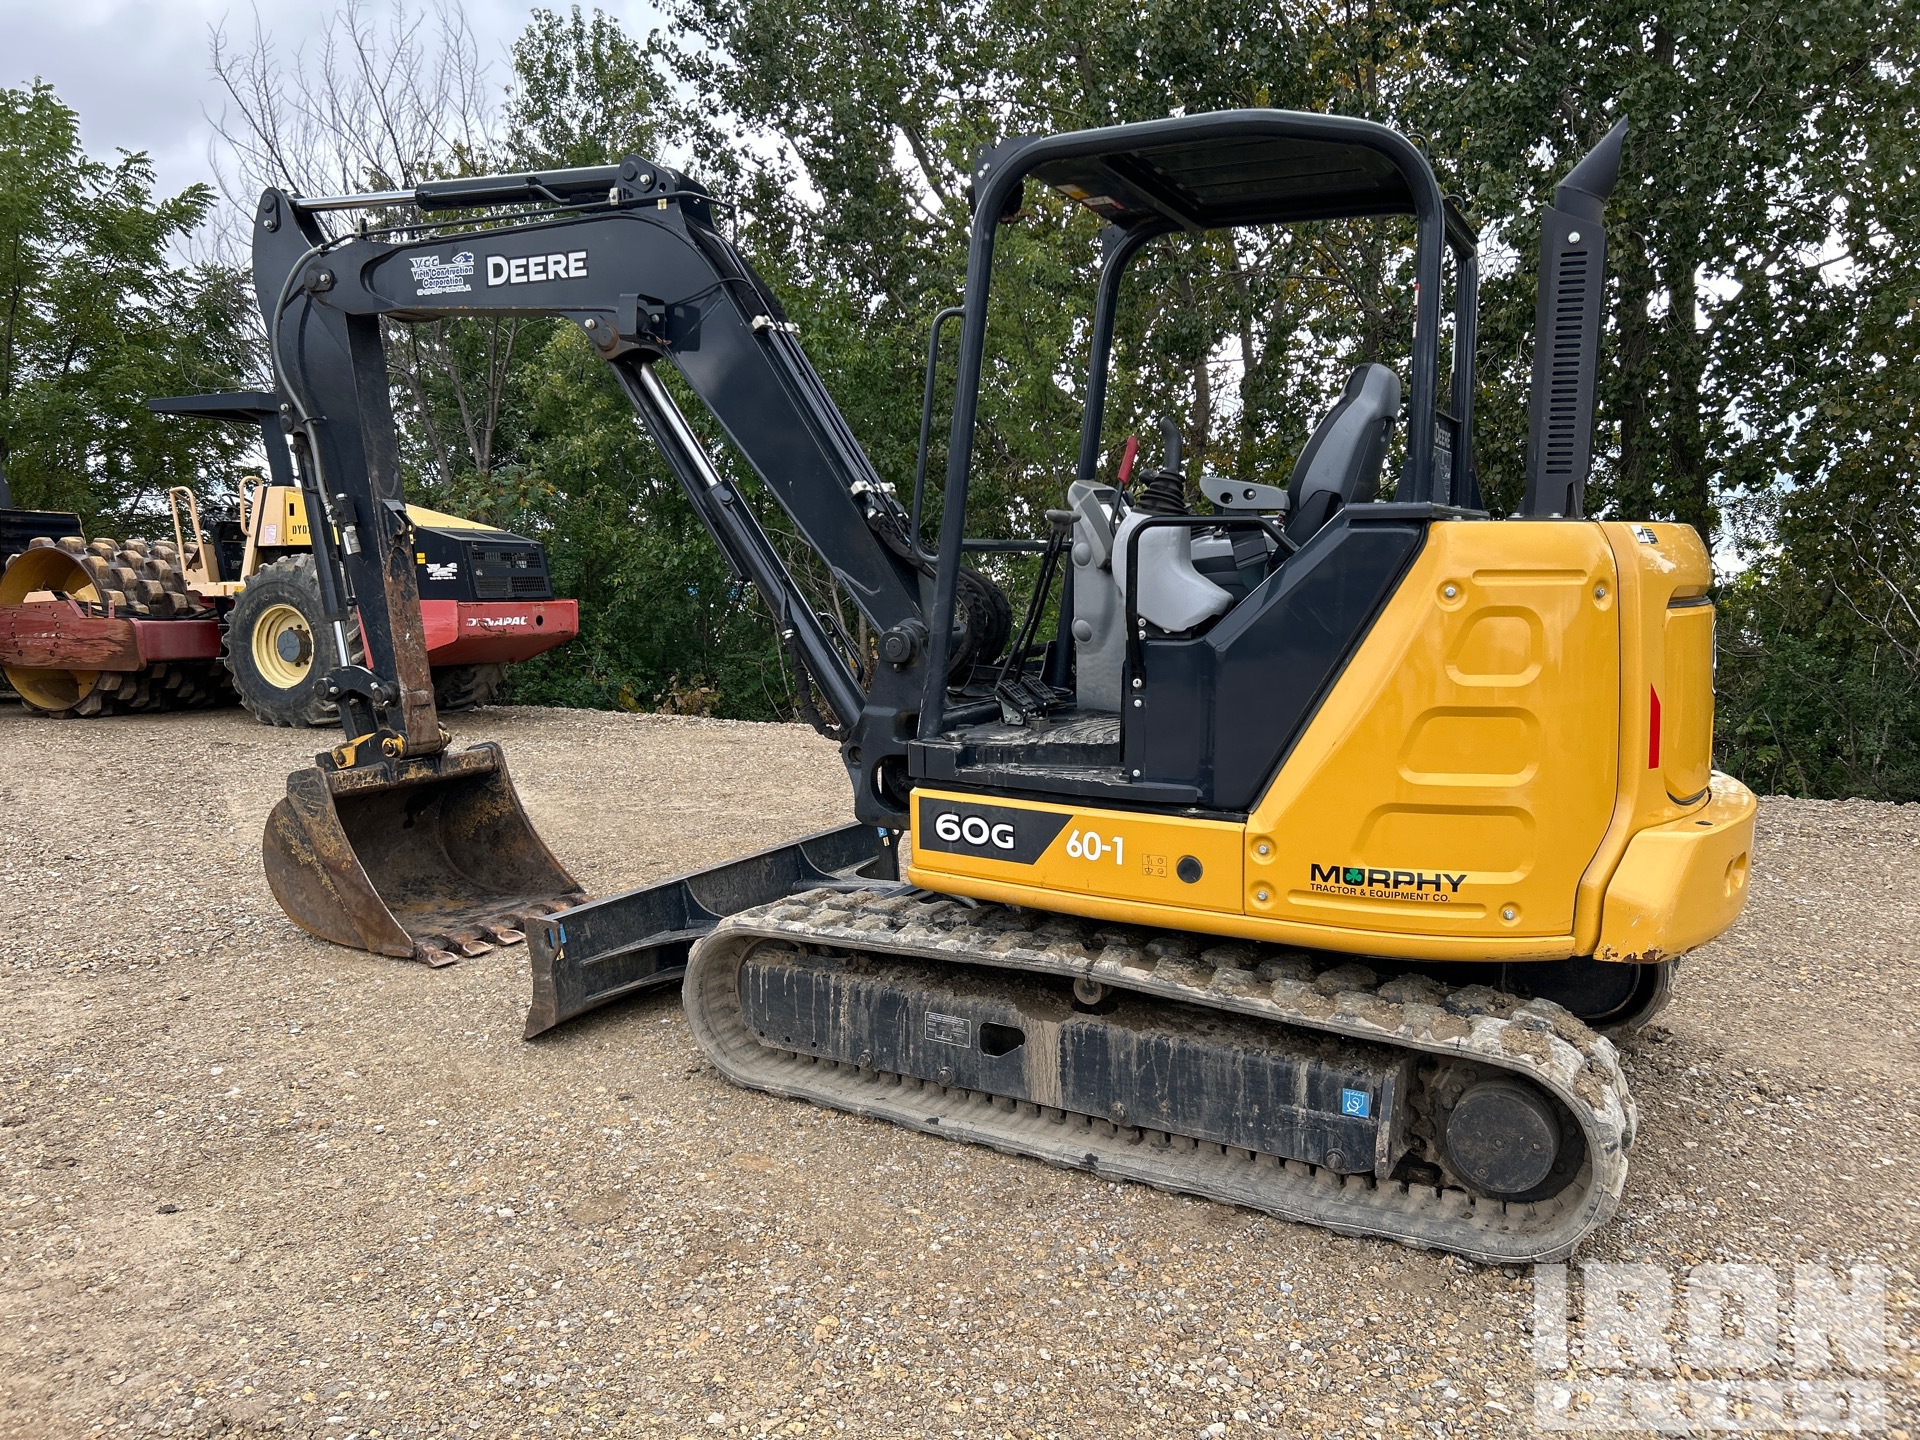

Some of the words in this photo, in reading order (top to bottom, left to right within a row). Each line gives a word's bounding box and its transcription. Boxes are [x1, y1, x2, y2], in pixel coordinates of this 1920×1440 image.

[412, 269, 430, 280] Vieth
[431, 266, 473, 278] Construction
[486, 251, 587, 286] DEERE
[423, 276, 463, 288] Corporation
[292, 525, 311, 534] DY0
[935, 813, 1014, 849] 60G
[1066, 829, 1124, 865] 60-1
[1310, 863, 1468, 893] MURPHY
[1310, 883, 1357, 896] TRACTOR
[1359, 888, 1367, 897] &
[1369, 889, 1430, 902] EQUIPMENT
[1432, 894, 1451, 903] CO.
